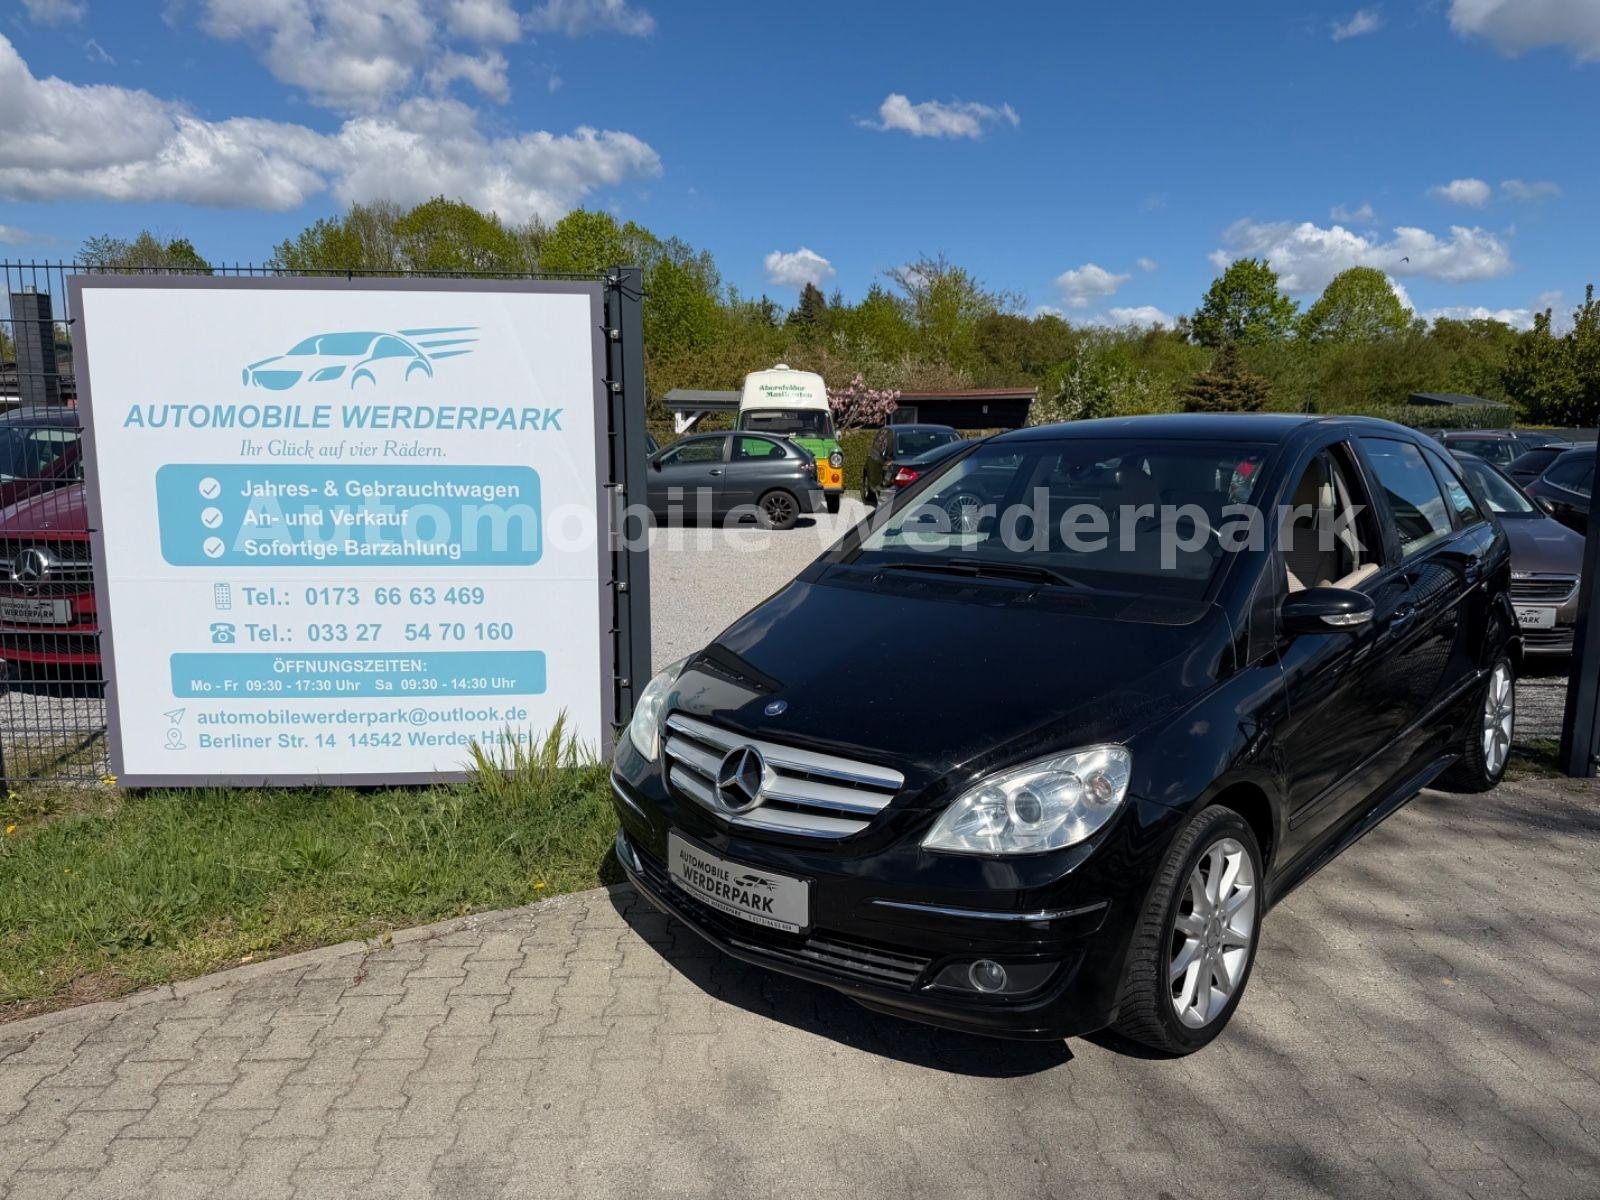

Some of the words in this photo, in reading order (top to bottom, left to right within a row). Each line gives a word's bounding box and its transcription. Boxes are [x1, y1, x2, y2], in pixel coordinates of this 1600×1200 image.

[124, 405, 331, 428] AUTOMOBILE
[342, 405, 563, 431] WERDERPARK
[240, 440, 262, 455] Ihr
[268, 440, 313, 459] Glück
[319, 440, 346, 459] auf
[350, 442, 377, 456] vier
[383, 440, 446, 456] Rädern.
[242, 481, 317, 499] Jahres-
[324, 481, 338, 496] &
[346, 481, 519, 501] Gebrauchtwagen
[243, 508, 279, 526] An-
[286, 509, 323, 526] und
[331, 509, 408, 526] Verkauf
[243, 537, 338, 559] Sofortige
[344, 539, 460, 559] Barzahlung
[242, 587, 289, 605] Tel.:
[305, 587, 359, 605] 0173
[375, 587, 401, 605] 66
[410, 587, 436, 605] 63
[444, 587, 484, 605] 469
[245, 624, 291, 641] Tel.:
[308, 624, 347, 641] 033
[356, 624, 382, 641] 27
[405, 623, 432, 641] 54
[439, 623, 465, 640] 70
[475, 623, 513, 640] 160
[274, 658, 426, 672] ÖFFNUNGSZEITEN:
[192, 680, 211, 691] Mo
[225, 680, 237, 690] Fr
[247, 680, 281, 691] 09:30
[296, 680, 331, 690] 17:30
[336, 680, 360, 690] Uhr
[376, 680, 392, 689] Sa
[401, 679, 437, 689] 09:30
[452, 678, 487, 689] 14:30
[492, 678, 515, 688] Uhr
[198, 706, 527, 727] automobilewerderpark@outlook.de
[199, 734, 271, 748] Berliner
[278, 734, 308, 748] Str.
[316, 734, 336, 747] 14
[348, 732, 401, 747] 14542
[408, 731, 476, 746] Werder
[679, 849, 729, 881] AUTOMOBILE
[682, 863, 775, 913] WERDERPARK
